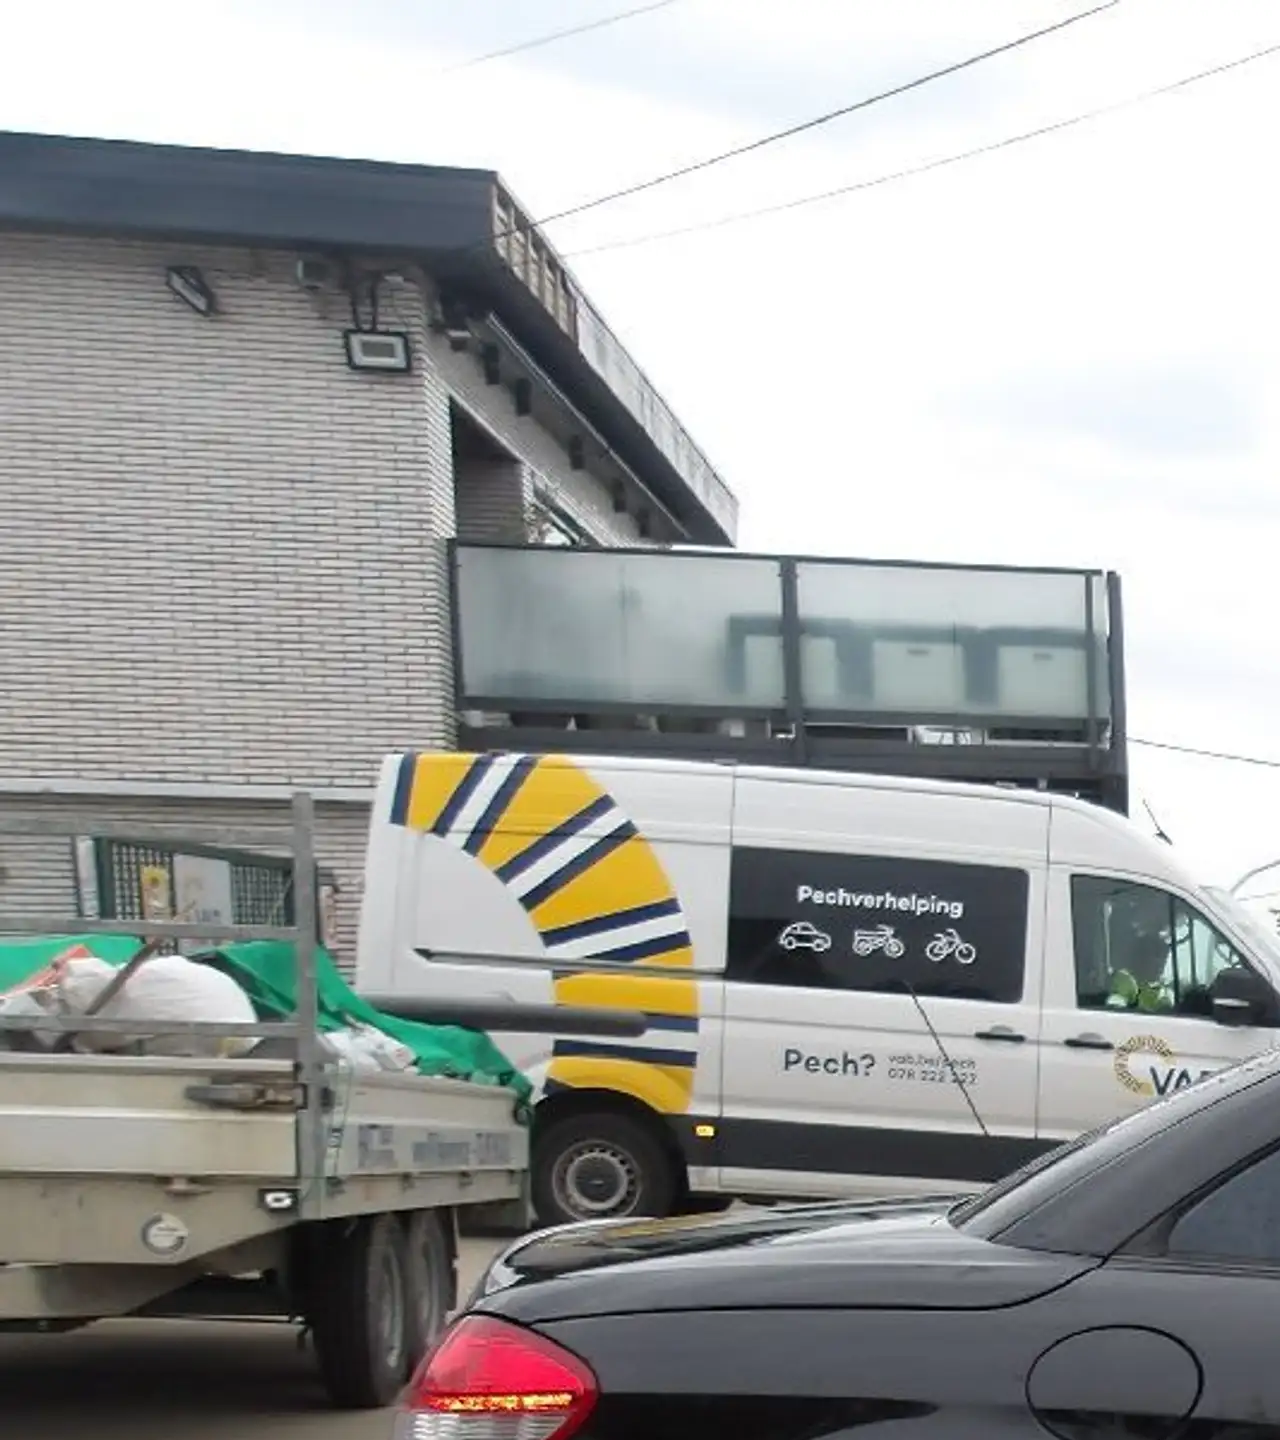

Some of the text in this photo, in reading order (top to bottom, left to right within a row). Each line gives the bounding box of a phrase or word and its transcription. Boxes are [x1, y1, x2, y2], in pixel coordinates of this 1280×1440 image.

[797, 884, 964, 919] Pechverhelping
[784, 1048, 875, 1077] Pech?
[921, 1069, 946, 1083] 222
